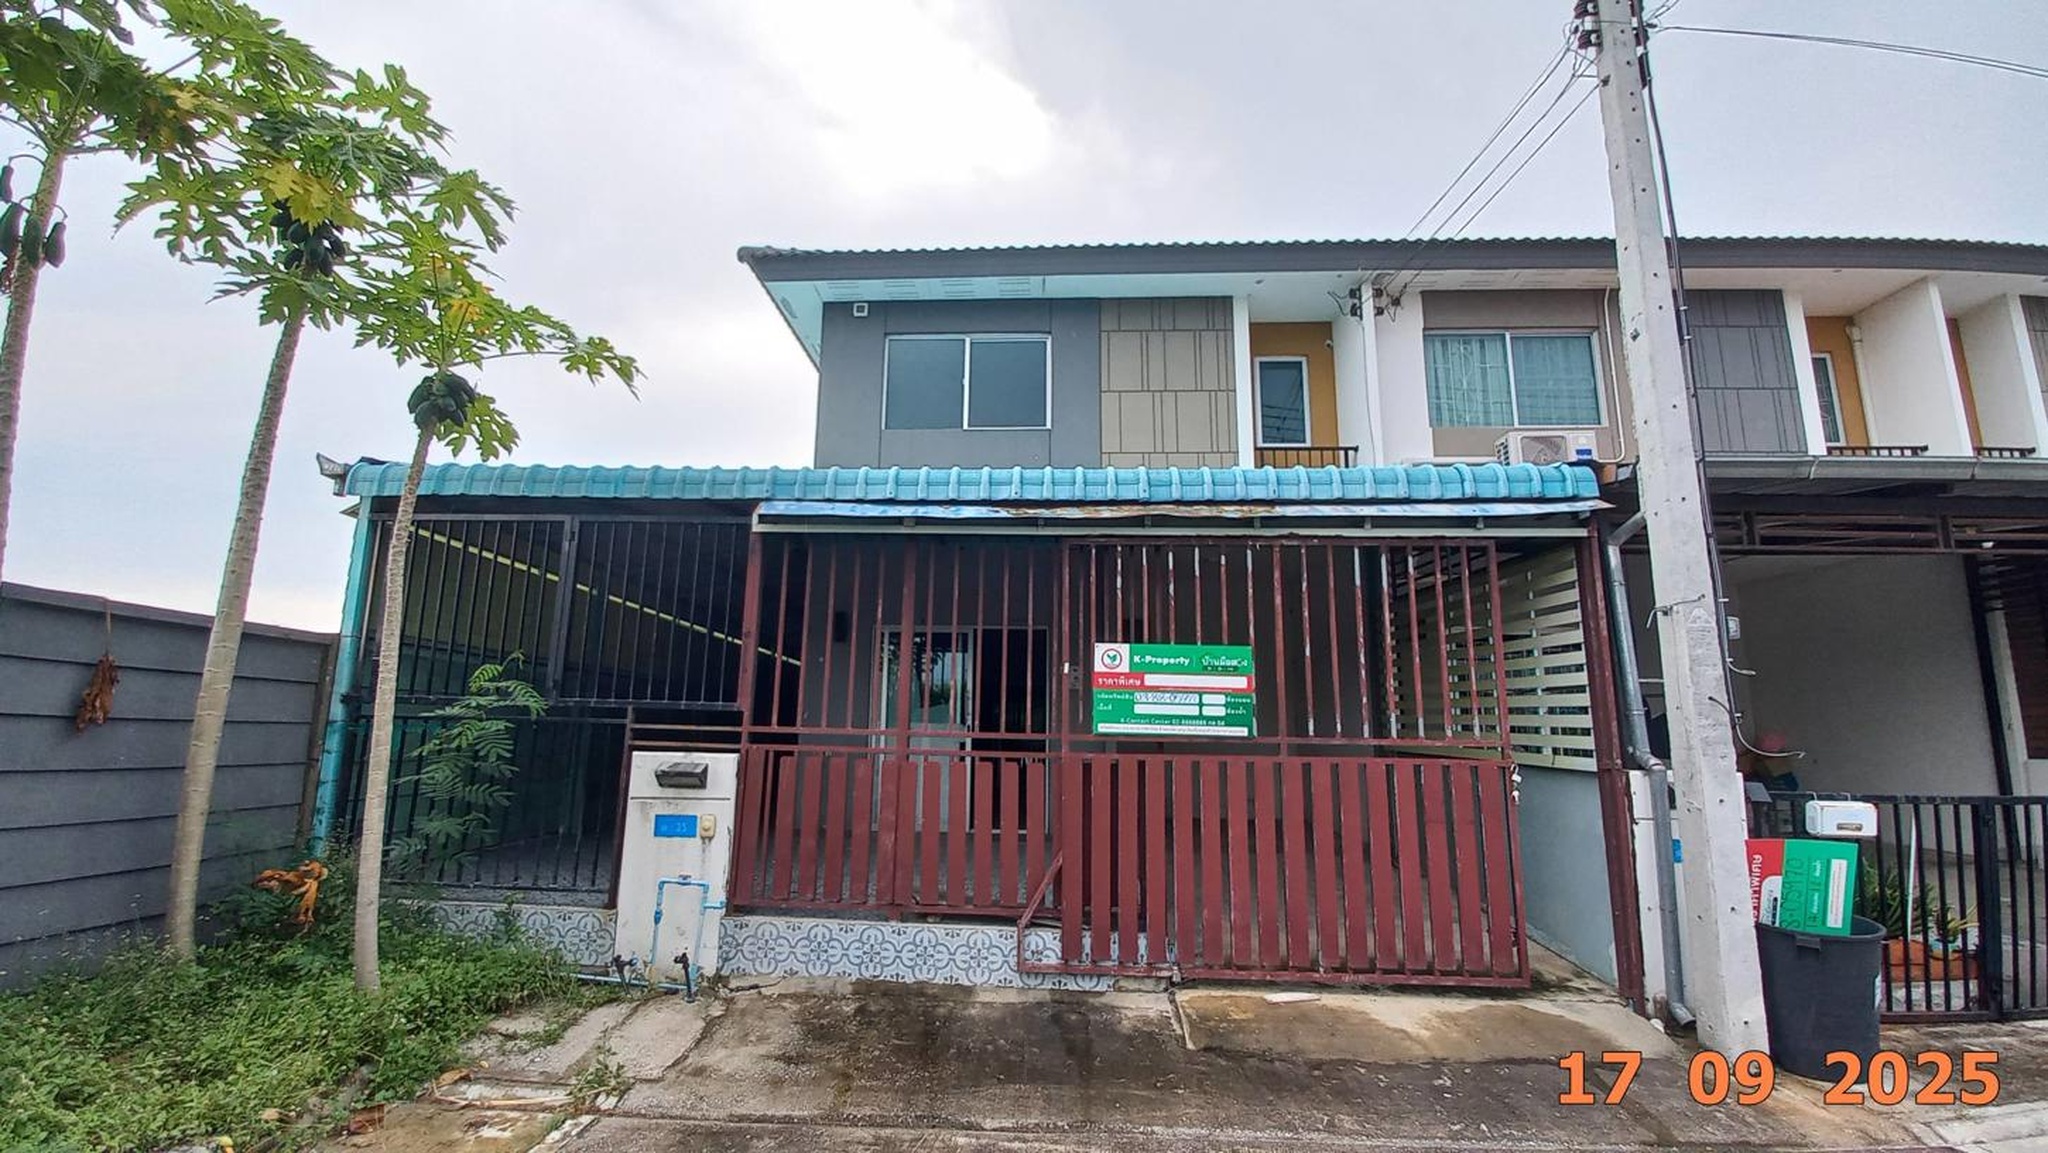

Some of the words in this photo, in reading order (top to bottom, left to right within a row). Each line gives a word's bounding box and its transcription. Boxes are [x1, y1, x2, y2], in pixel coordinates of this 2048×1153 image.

[1133, 655, 1190, 667] K-Property
[1097, 675, 1141, 688] ราคาพิเศษ
